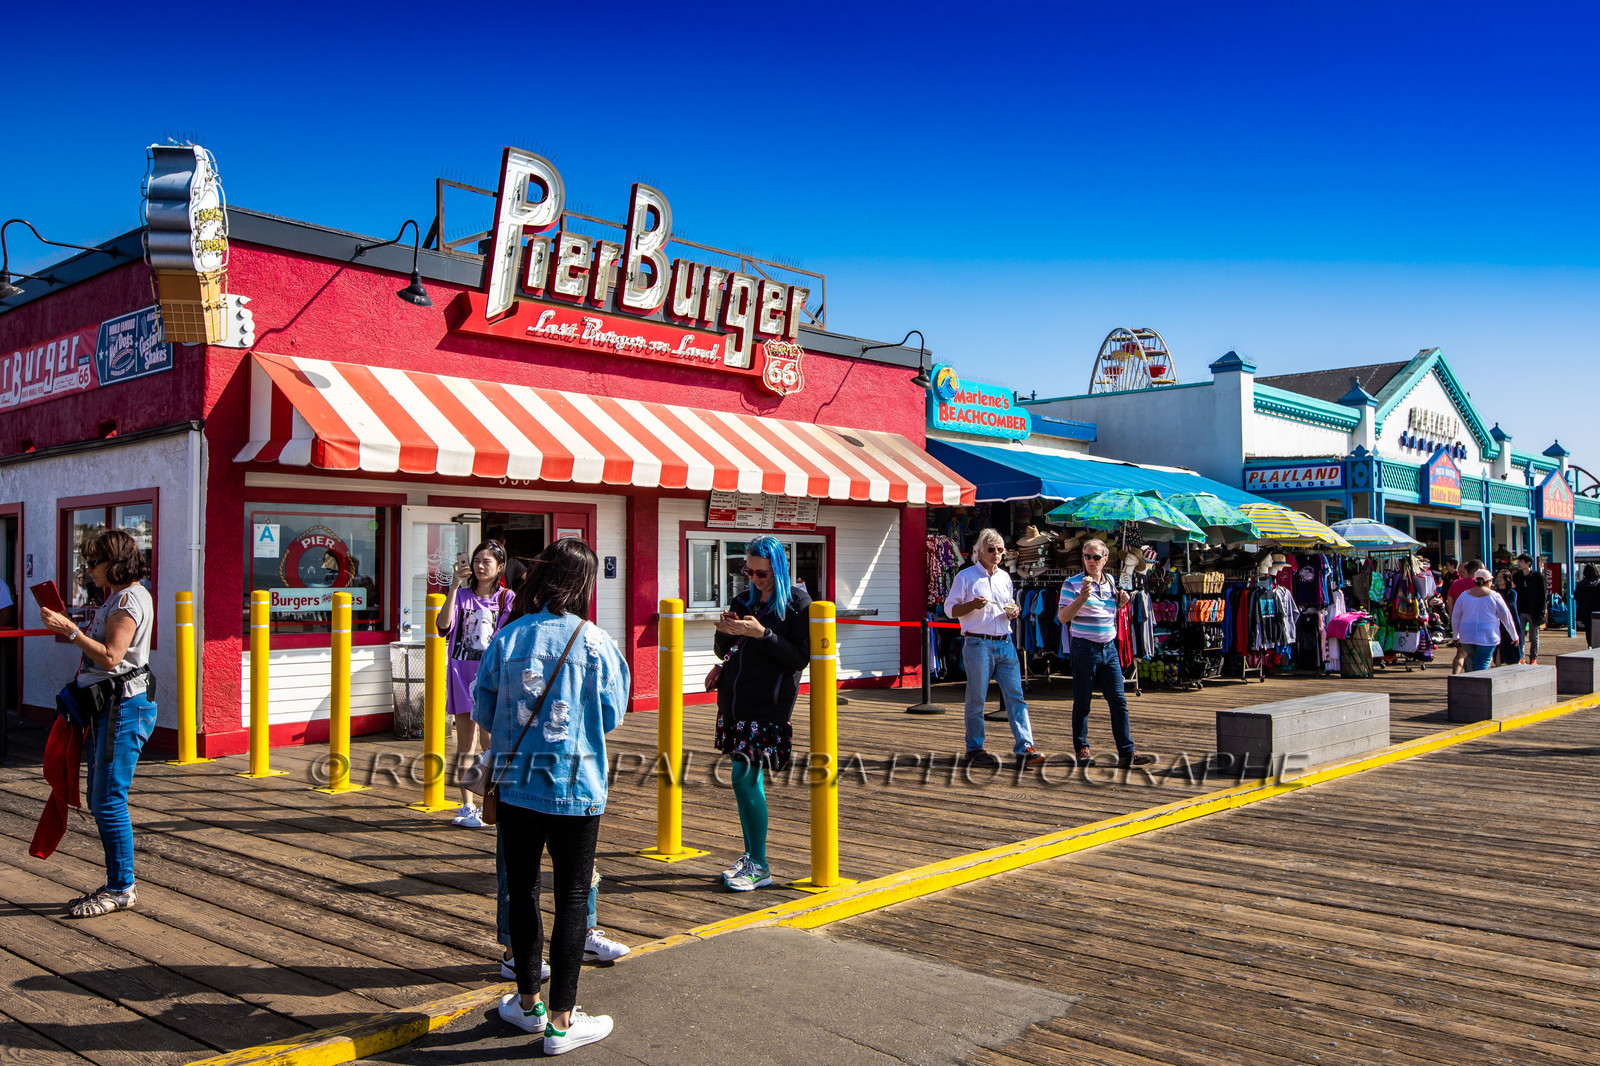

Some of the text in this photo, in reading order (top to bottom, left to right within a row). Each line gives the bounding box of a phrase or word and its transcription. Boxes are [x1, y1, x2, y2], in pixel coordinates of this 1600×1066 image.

[118, 332, 133, 350] Dogs
[144, 347, 167, 370] Shakes
[79, 367, 89, 385] 66
[768, 360, 798, 386] 66
[953, 387, 1010, 410] Marlene's
[938, 402, 1027, 431] BEACHCOMBER
[1248, 467, 1340, 484] PLAYLAND
[1261, 481, 1326, 489] ARCADE
[1545, 499, 1571, 518] PRIZES
[259, 526, 274, 542] A
[301, 536, 335, 549] PIER
[271, 591, 320, 610] Burgers
